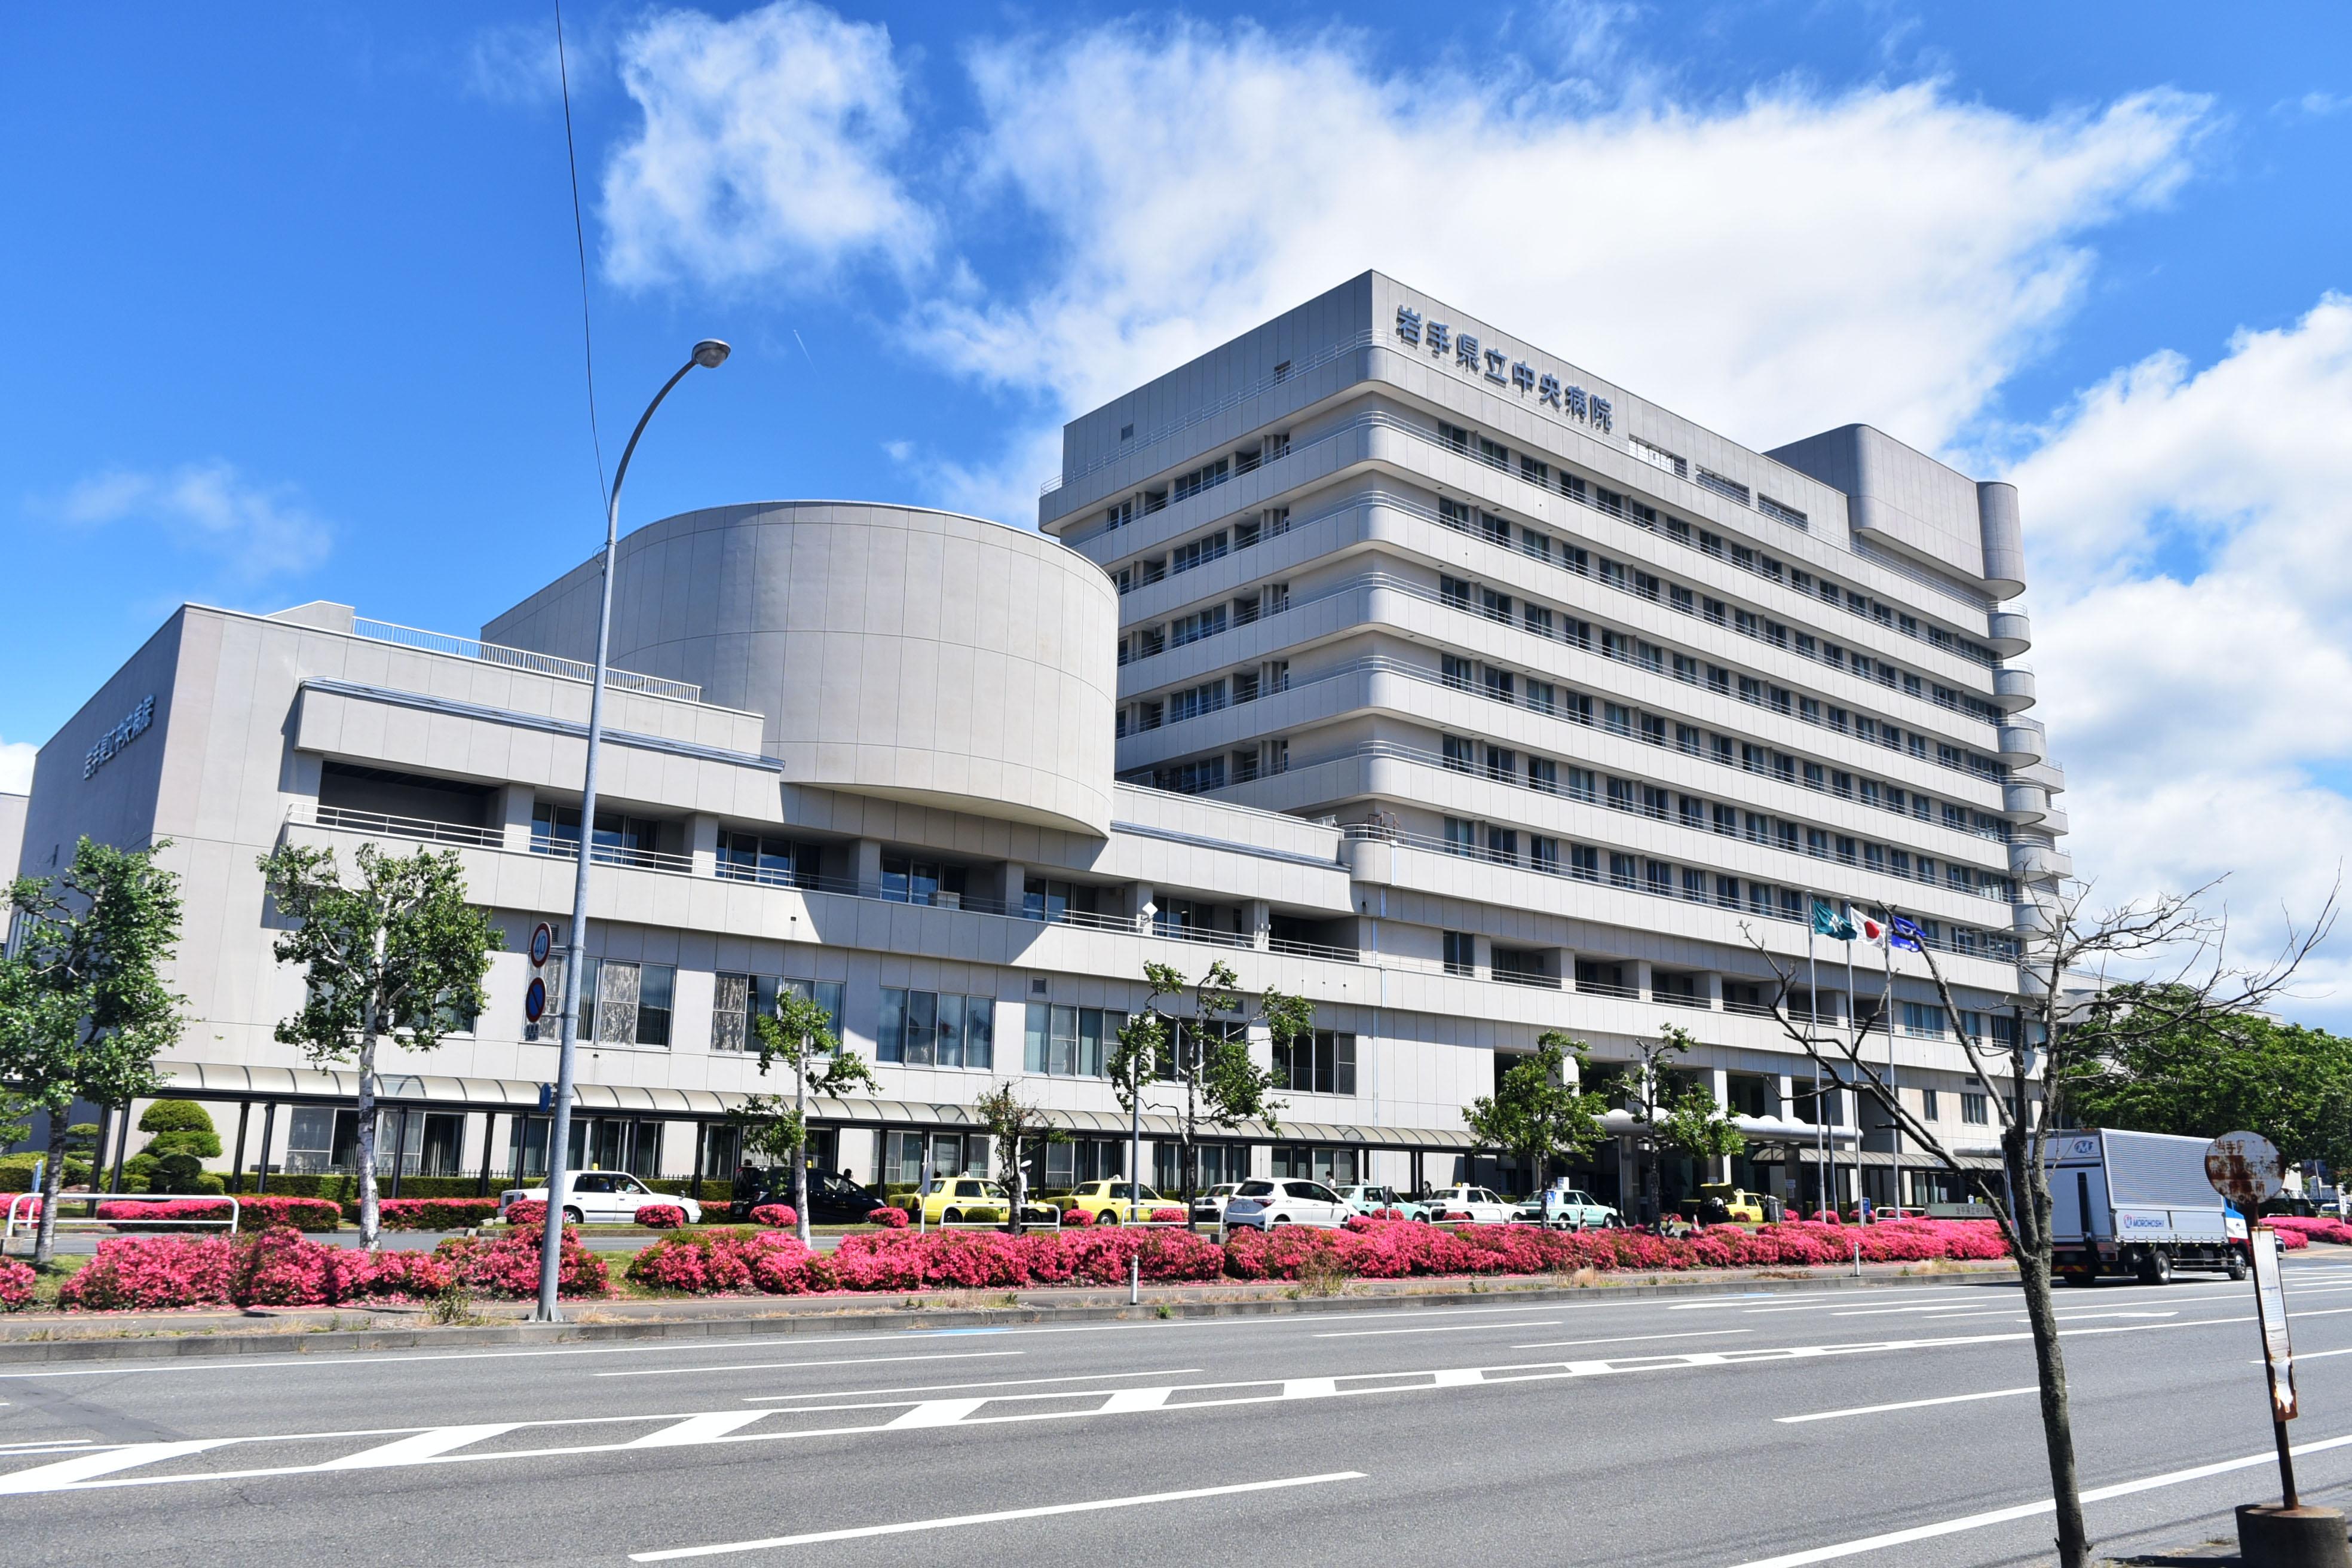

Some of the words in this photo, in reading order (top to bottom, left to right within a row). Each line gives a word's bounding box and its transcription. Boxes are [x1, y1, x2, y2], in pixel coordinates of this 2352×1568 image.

[1396, 305, 1613, 431] 岩手県立中央病院
[534, 935, 546, 955] 40
